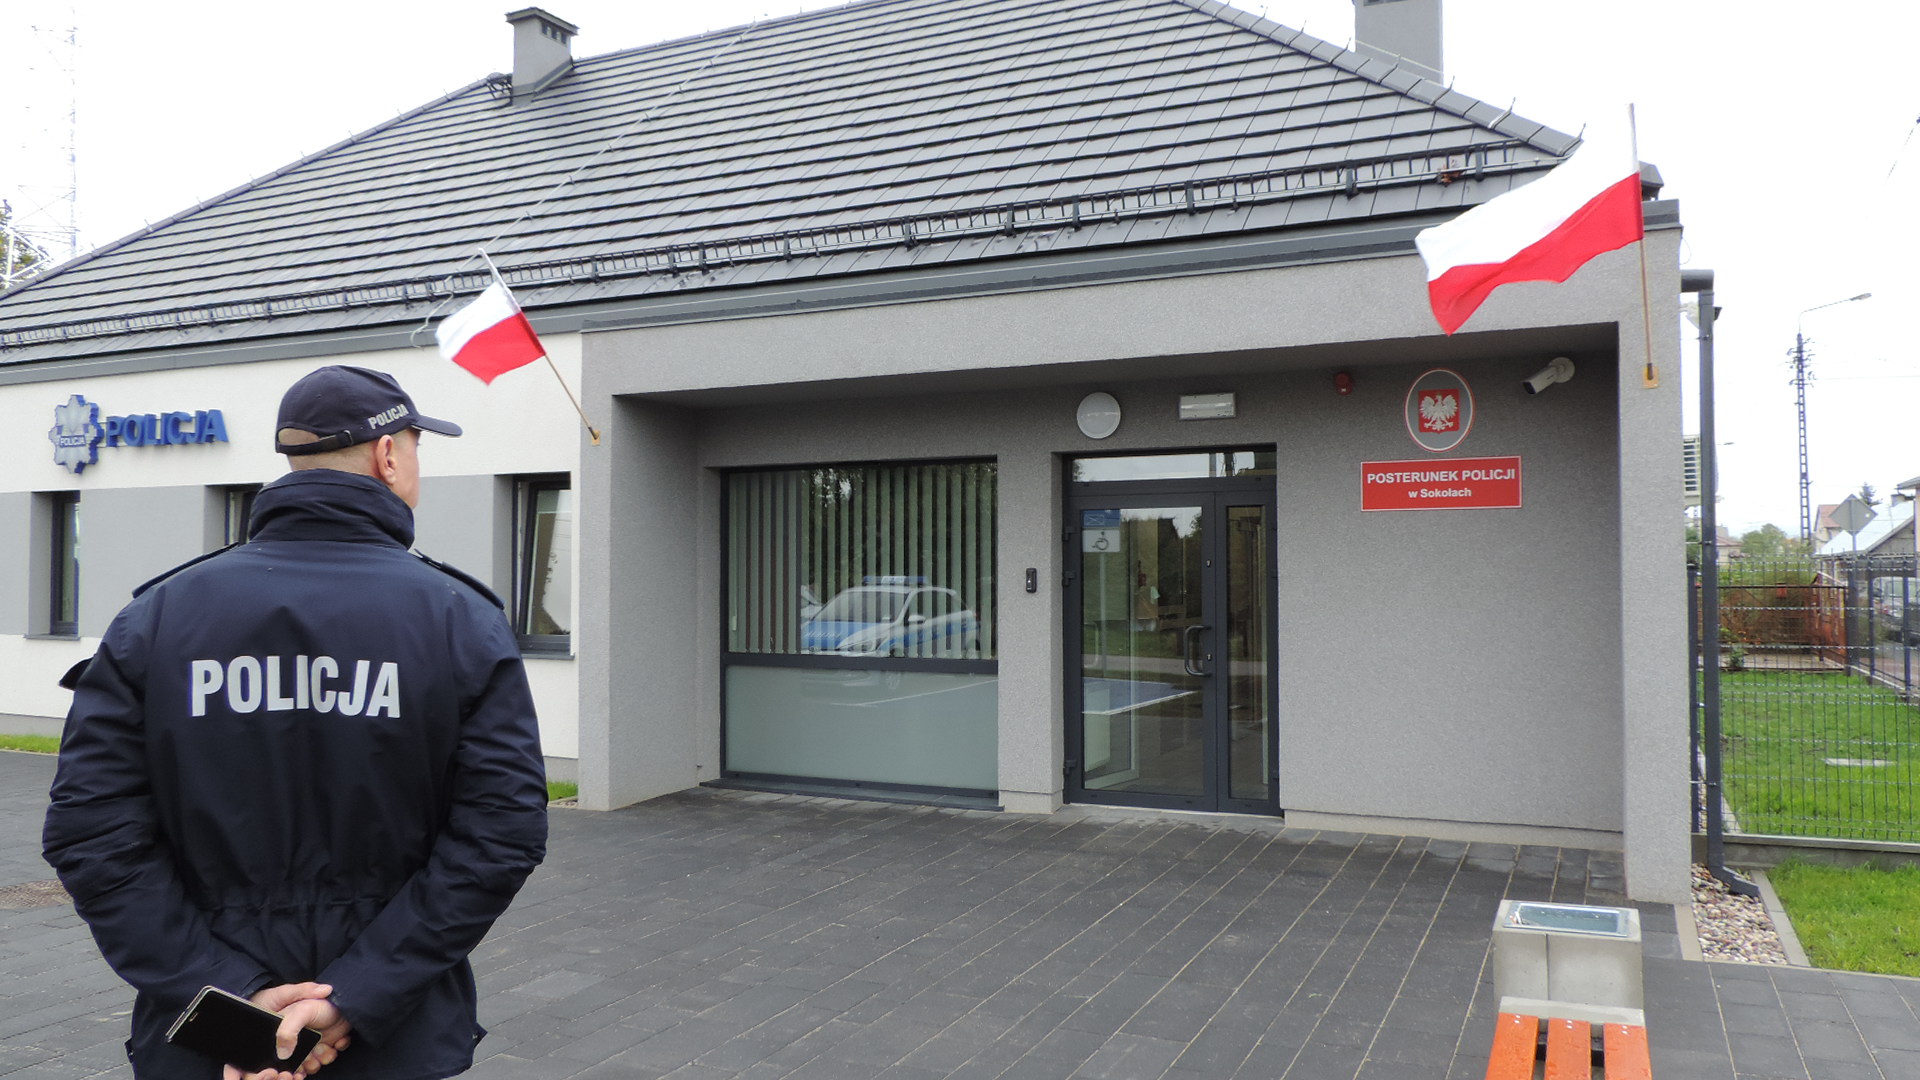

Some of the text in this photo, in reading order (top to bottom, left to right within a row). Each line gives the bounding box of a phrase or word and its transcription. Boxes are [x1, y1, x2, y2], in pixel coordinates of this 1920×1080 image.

[367, 403, 409, 430] POLICJA
[106, 409, 230, 447] POLICJA
[60, 436, 86, 446] POLICJA
[1367, 468, 1515, 484] POSTERUNEK POLICJI
[1408, 490, 1418, 498] w
[191, 655, 400, 718] POLICJA
